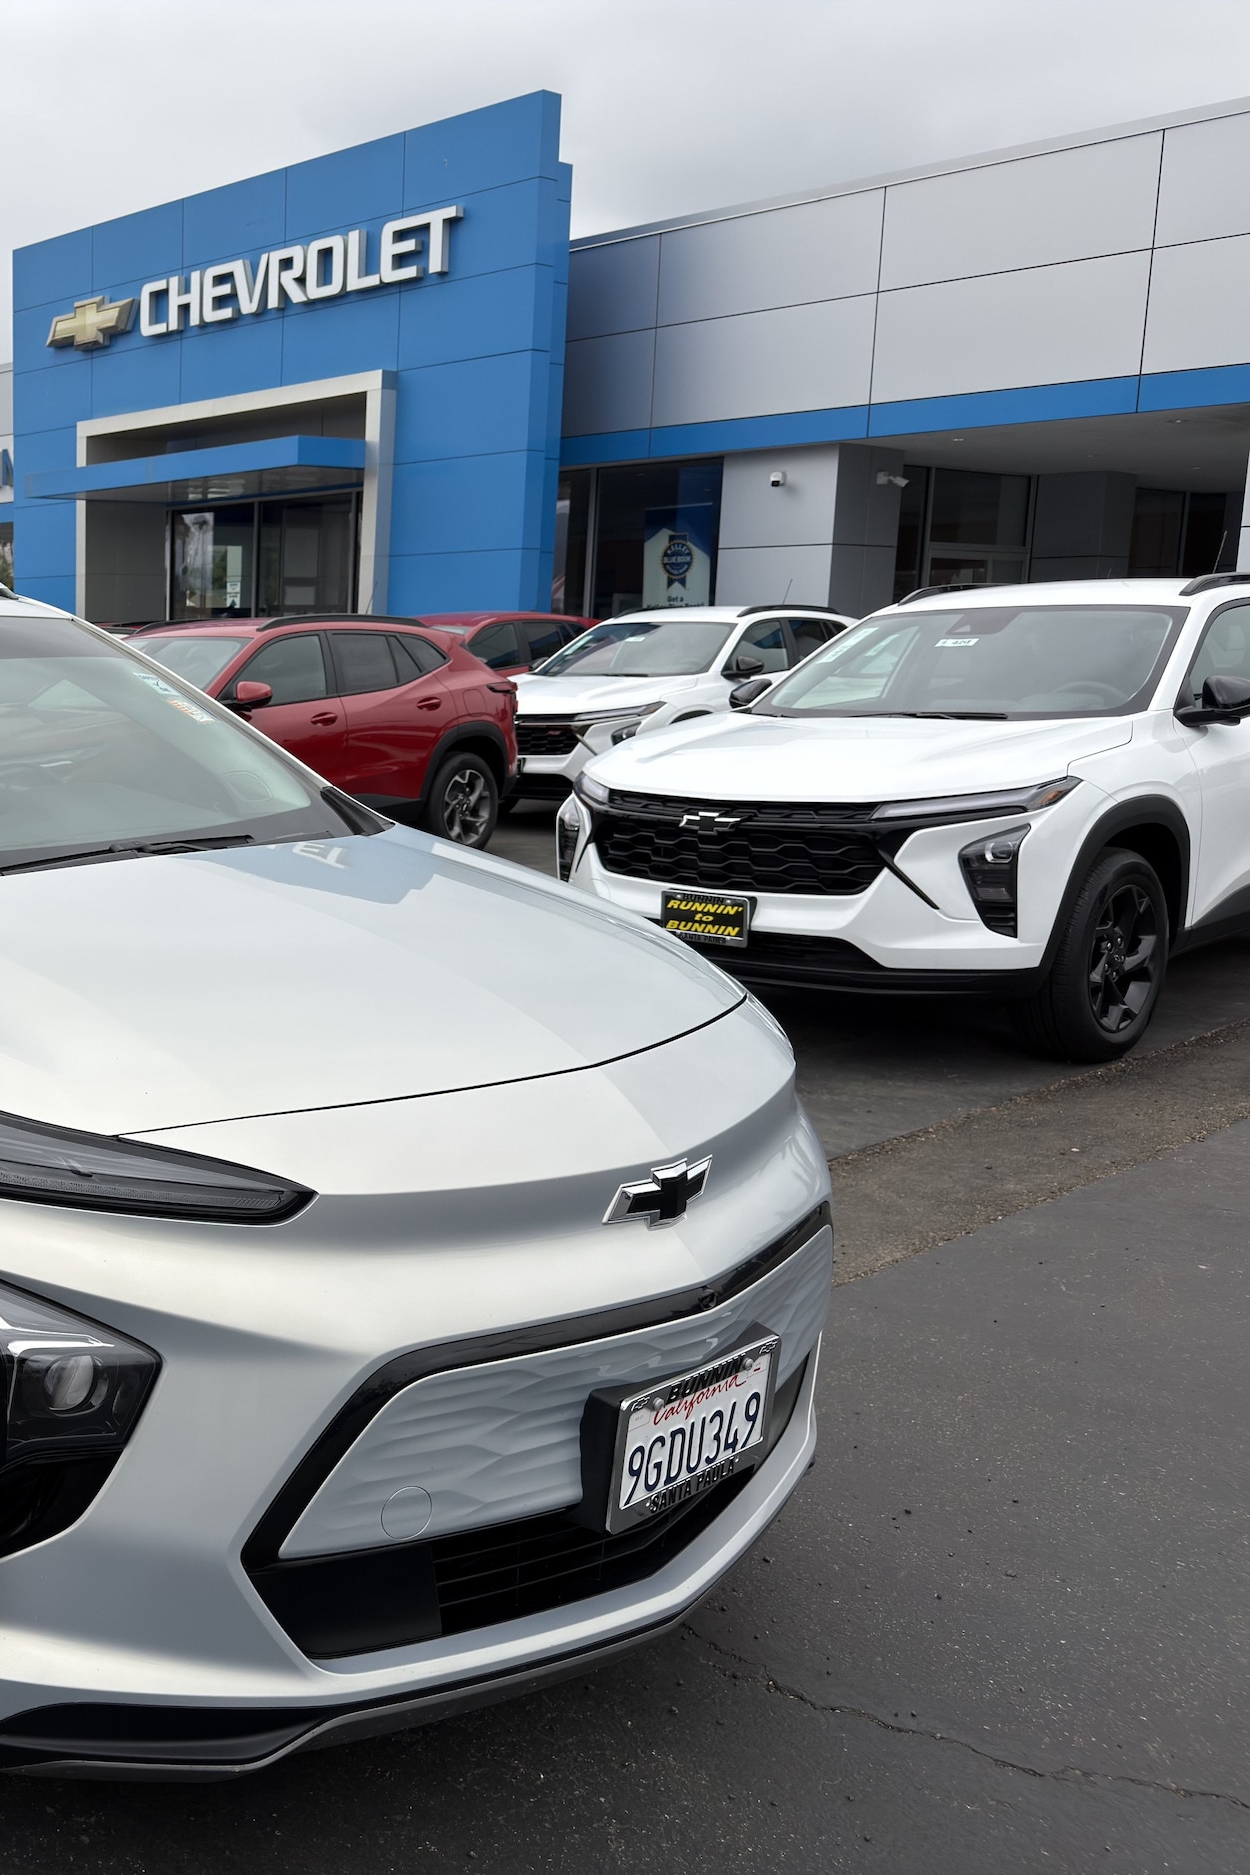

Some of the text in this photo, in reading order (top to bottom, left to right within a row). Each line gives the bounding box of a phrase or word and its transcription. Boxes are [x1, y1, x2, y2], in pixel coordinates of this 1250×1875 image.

[140, 205, 464, 338] CHEVROLET
[666, 920, 740, 936] BUNNIN
[667, 899, 744, 915] RUNNIN'
[694, 913, 714, 922] to
[653, 1373, 747, 1426] California
[665, 1352, 746, 1405] BUNNIN
[625, 1392, 760, 1506] 9GDU349
[652, 1458, 735, 1514] SANTA PAULA
